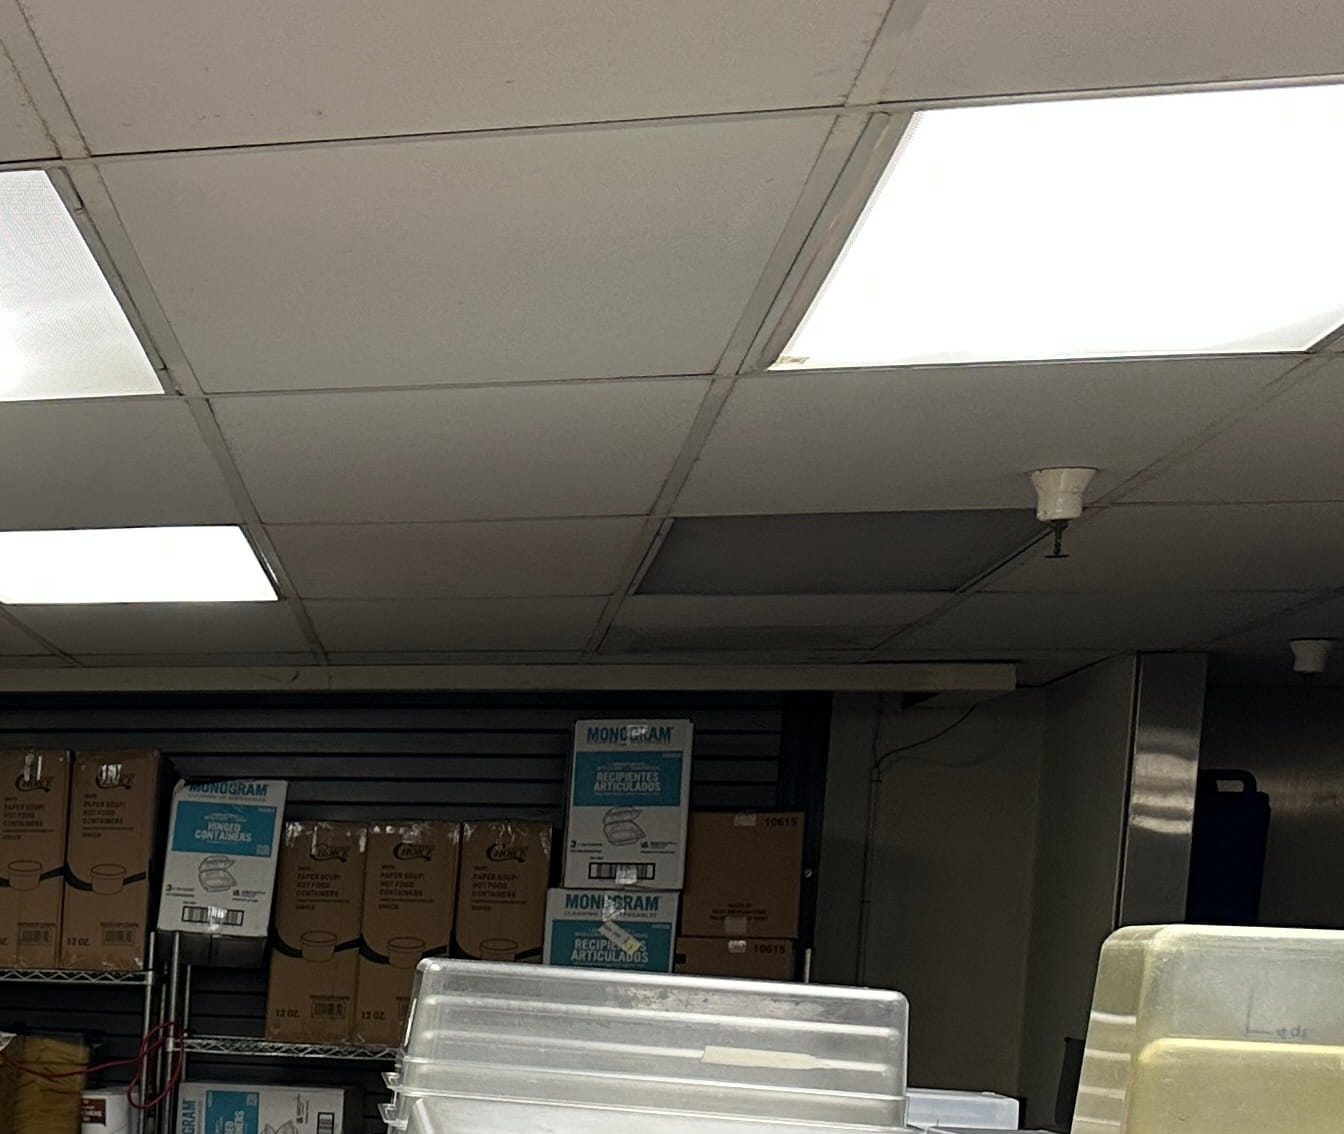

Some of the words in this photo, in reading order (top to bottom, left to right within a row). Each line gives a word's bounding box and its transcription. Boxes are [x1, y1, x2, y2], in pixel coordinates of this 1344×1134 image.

[597, 773, 659, 782] RECIPIENTES
[189, 784, 268, 797] MONOGRAM
[594, 782, 660, 792] ARTICULADOS
[194, 829, 252, 843] CONTAINERS
[574, 938, 647, 952] RECIPIES
[571, 950, 649, 963] ARTICULADOS
